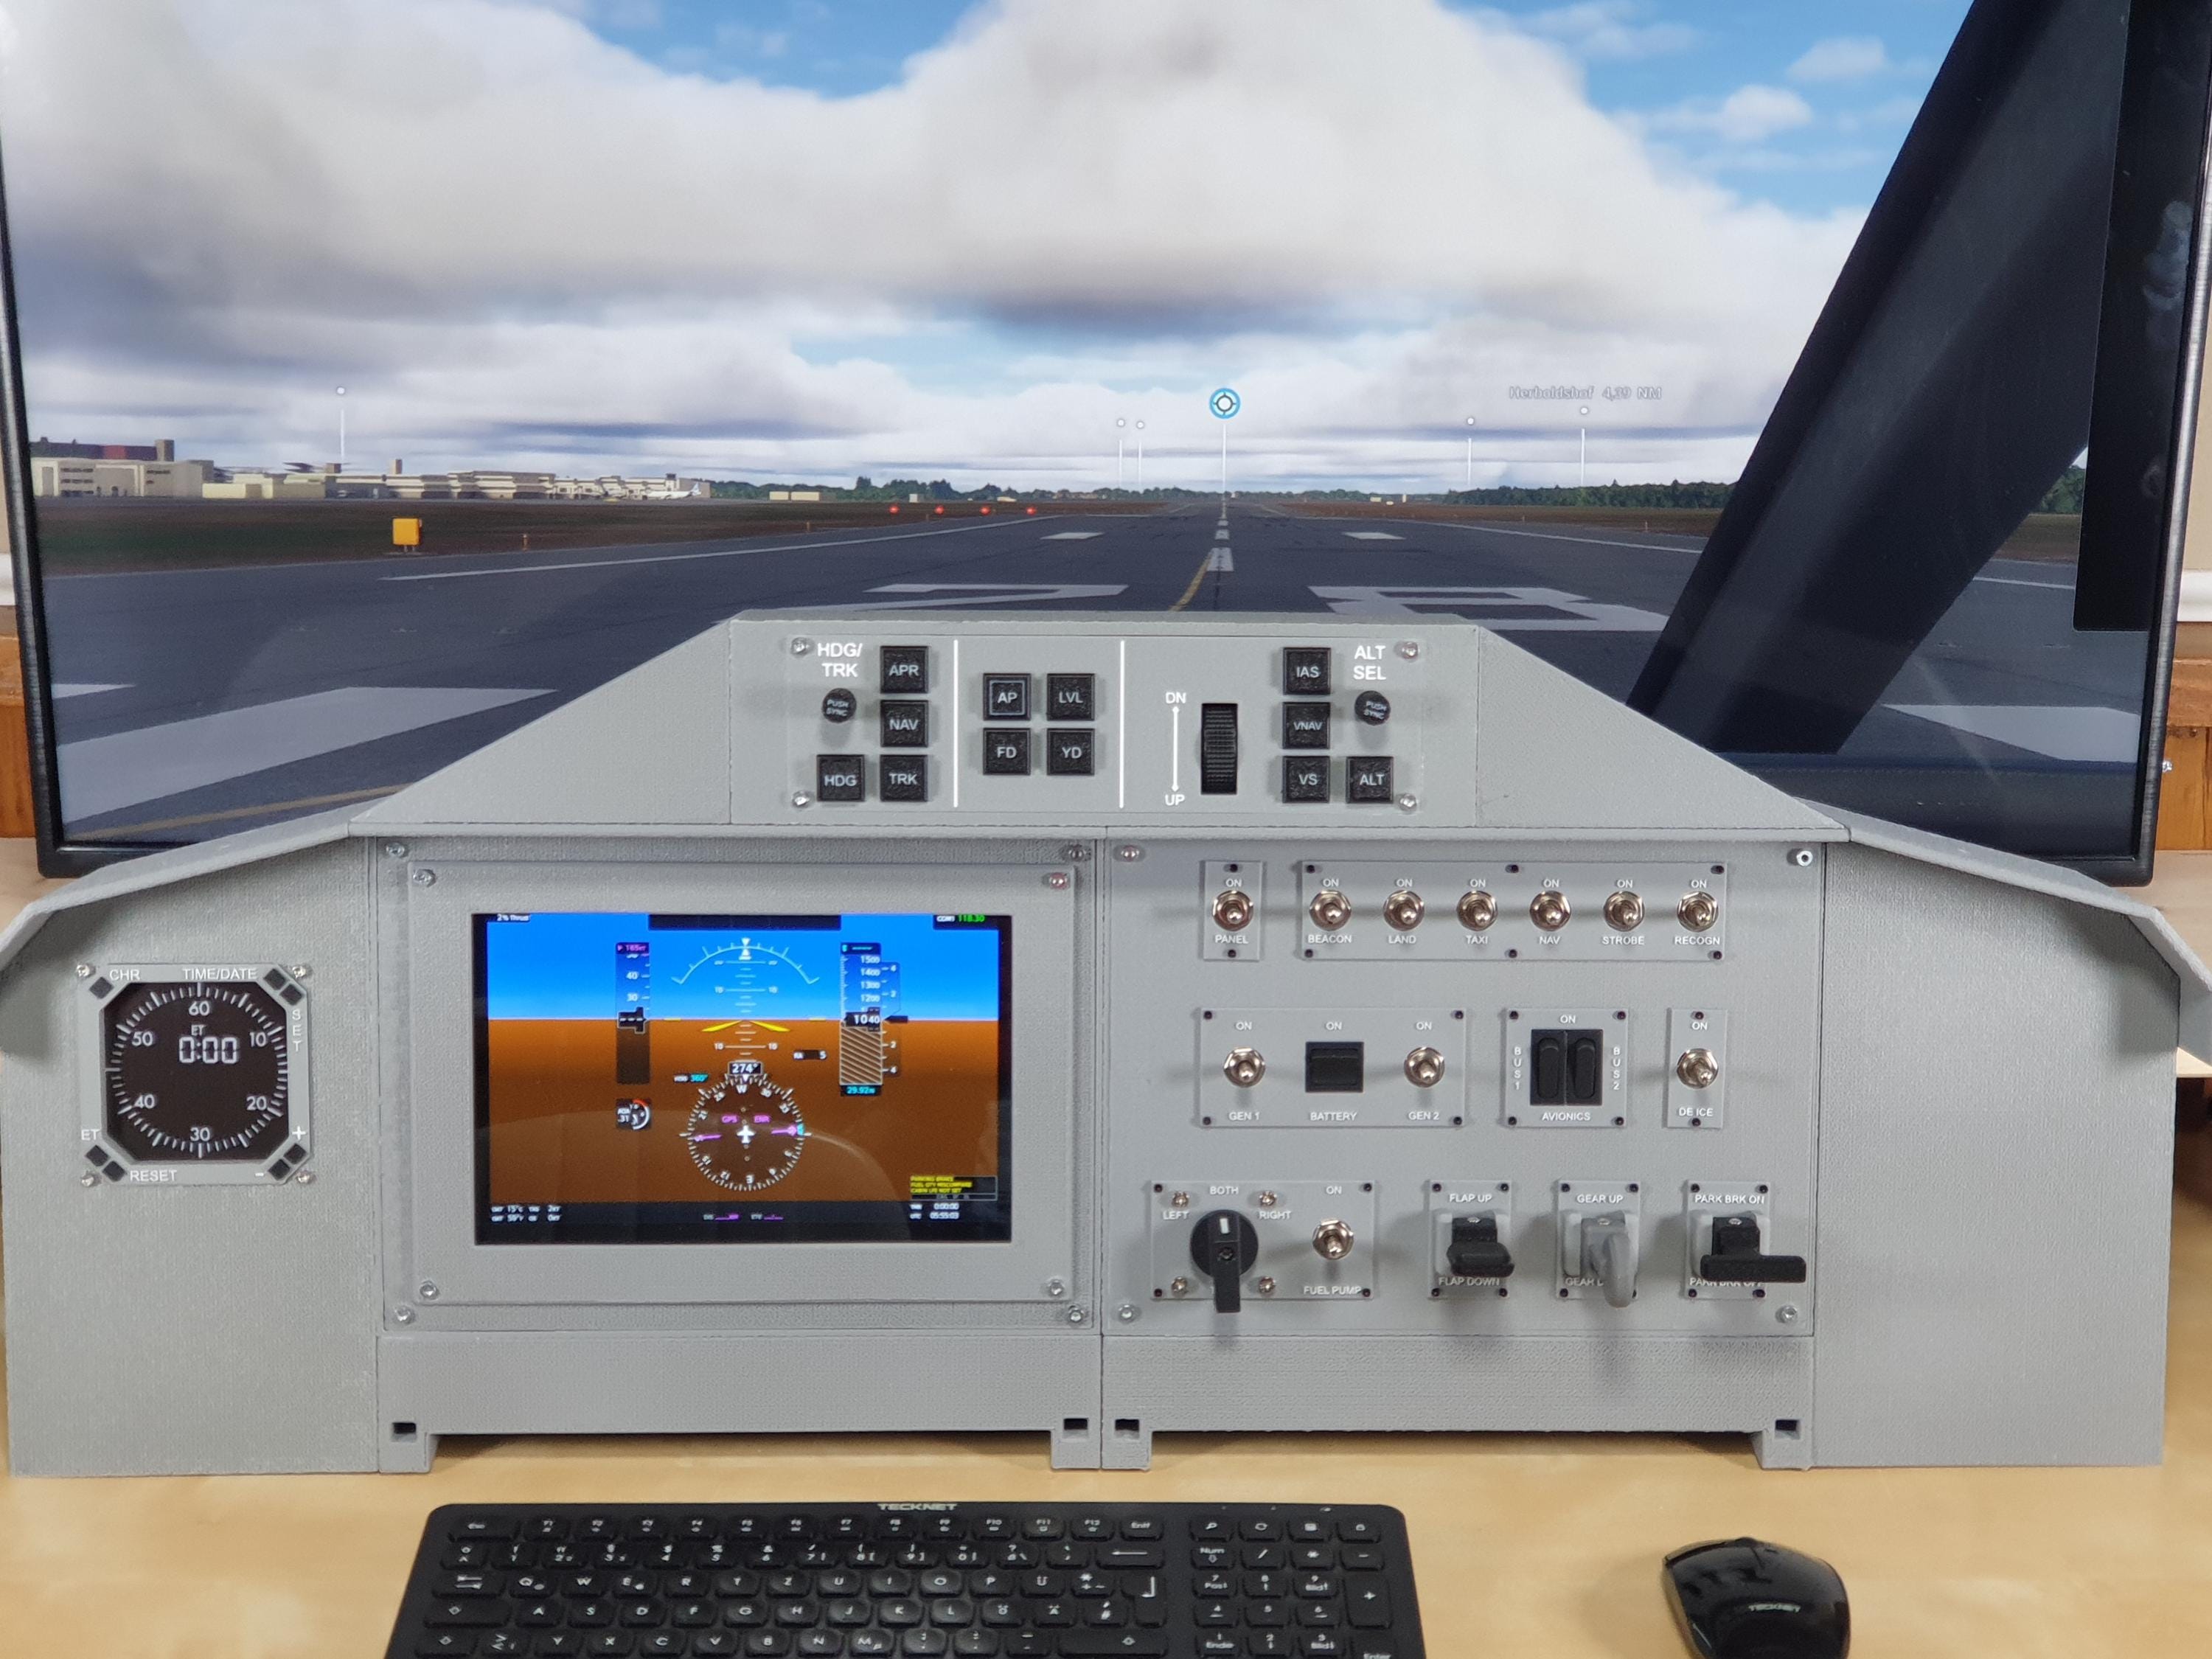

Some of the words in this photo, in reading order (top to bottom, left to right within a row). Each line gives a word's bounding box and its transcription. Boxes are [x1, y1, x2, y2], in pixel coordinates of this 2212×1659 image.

[1637, 386, 1662, 399] NM
[817, 642, 862, 658] HDG/
[1354, 646, 1386, 660] ALT
[821, 663, 858, 678] TRK
[888, 664, 919, 677] APR
[1296, 667, 1320, 678] IAS
[1353, 666, 1386, 680] SEL
[997, 692, 1018, 704] AP
[1058, 692, 1083, 703] LVL
[1166, 692, 1186, 704] DN
[889, 719, 918, 731] NAV
[1293, 722, 1323, 731] VNAV
[997, 747, 1017, 759] FD
[1061, 747, 1082, 759] YD
[824, 775, 857, 787] HDG
[888, 773, 917, 785] TRK
[1298, 773, 1318, 785] VS
[1360, 774, 1385, 785] ALT
[1164, 795, 1186, 807] UP
[1225, 879, 1242, 887] ON
[1323, 879, 1339, 887] ON
[1397, 879, 1413, 887] ON
[1470, 879, 1486, 888] ON
[1543, 879, 1559, 888] ON
[1617, 879, 1633, 888] ON
[1691, 880, 1707, 888] ON
[1215, 935, 1249, 944] PANEL
[1308, 935, 1352, 944] BEACON
[1388, 936, 1416, 944] LAND
[1466, 936, 1489, 945] TAXI
[1539, 936, 1560, 945] NAV
[1602, 936, 1645, 945] STROBE
[1674, 936, 1720, 945] RECOGN
[110, 969, 141, 981] CHR
[183, 968, 257, 980] TIME/DATE
[189, 1001, 210, 1016] 60
[854, 1015, 880, 1024] 1040
[1560, 1015, 1576, 1023] ON
[191, 1024, 206, 1036] ET
[292, 1009, 302, 1051] SET
[1236, 1021, 1252, 1030] ON
[1326, 1021, 1342, 1031] ON
[1416, 1021, 1432, 1030] ON
[1691, 1022, 1708, 1030] ON
[131, 1032, 153, 1046] 50
[249, 1032, 267, 1046] 10
[178, 1037, 240, 1064] 0:00
[134, 1094, 156, 1109] 40
[246, 1096, 268, 1110] 20
[1229, 1112, 1252, 1121] GEN
[1254, 1112, 1260, 1121] 1
[1310, 1112, 1357, 1121] BATTERY
[1408, 1111, 1430, 1120] GEN
[1432, 1111, 1440, 1120] 2
[1542, 1113, 1590, 1121] AVIONICS
[1679, 1108, 1694, 1117] DE
[1697, 1108, 1714, 1117] ICE
[81, 1129, 100, 1140] ET
[190, 1127, 210, 1141] 30
[130, 1170, 178, 1182] RESET
[1210, 1186, 1239, 1194] BOTH
[1326, 1186, 1342, 1194] ON
[1449, 1194, 1475, 1203] FLAP
[1477, 1194, 1492, 1203] UP
[1577, 1194, 1606, 1203] GEAR
[1609, 1194, 1624, 1203] UP
[1695, 1195, 1722, 1203] PARK
[1725, 1195, 1747, 1203] BRK
[1748, 1195, 1765, 1204] ON
[1163, 1211, 1189, 1220] LEFT
[1259, 1211, 1291, 1220] RIGHT
[1439, 1277, 1465, 1286] FLAP
[1467, 1277, 1500, 1286] DOWN
[1304, 1287, 1329, 1295] FUEL
[1332, 1286, 1361, 1295] PUMP
